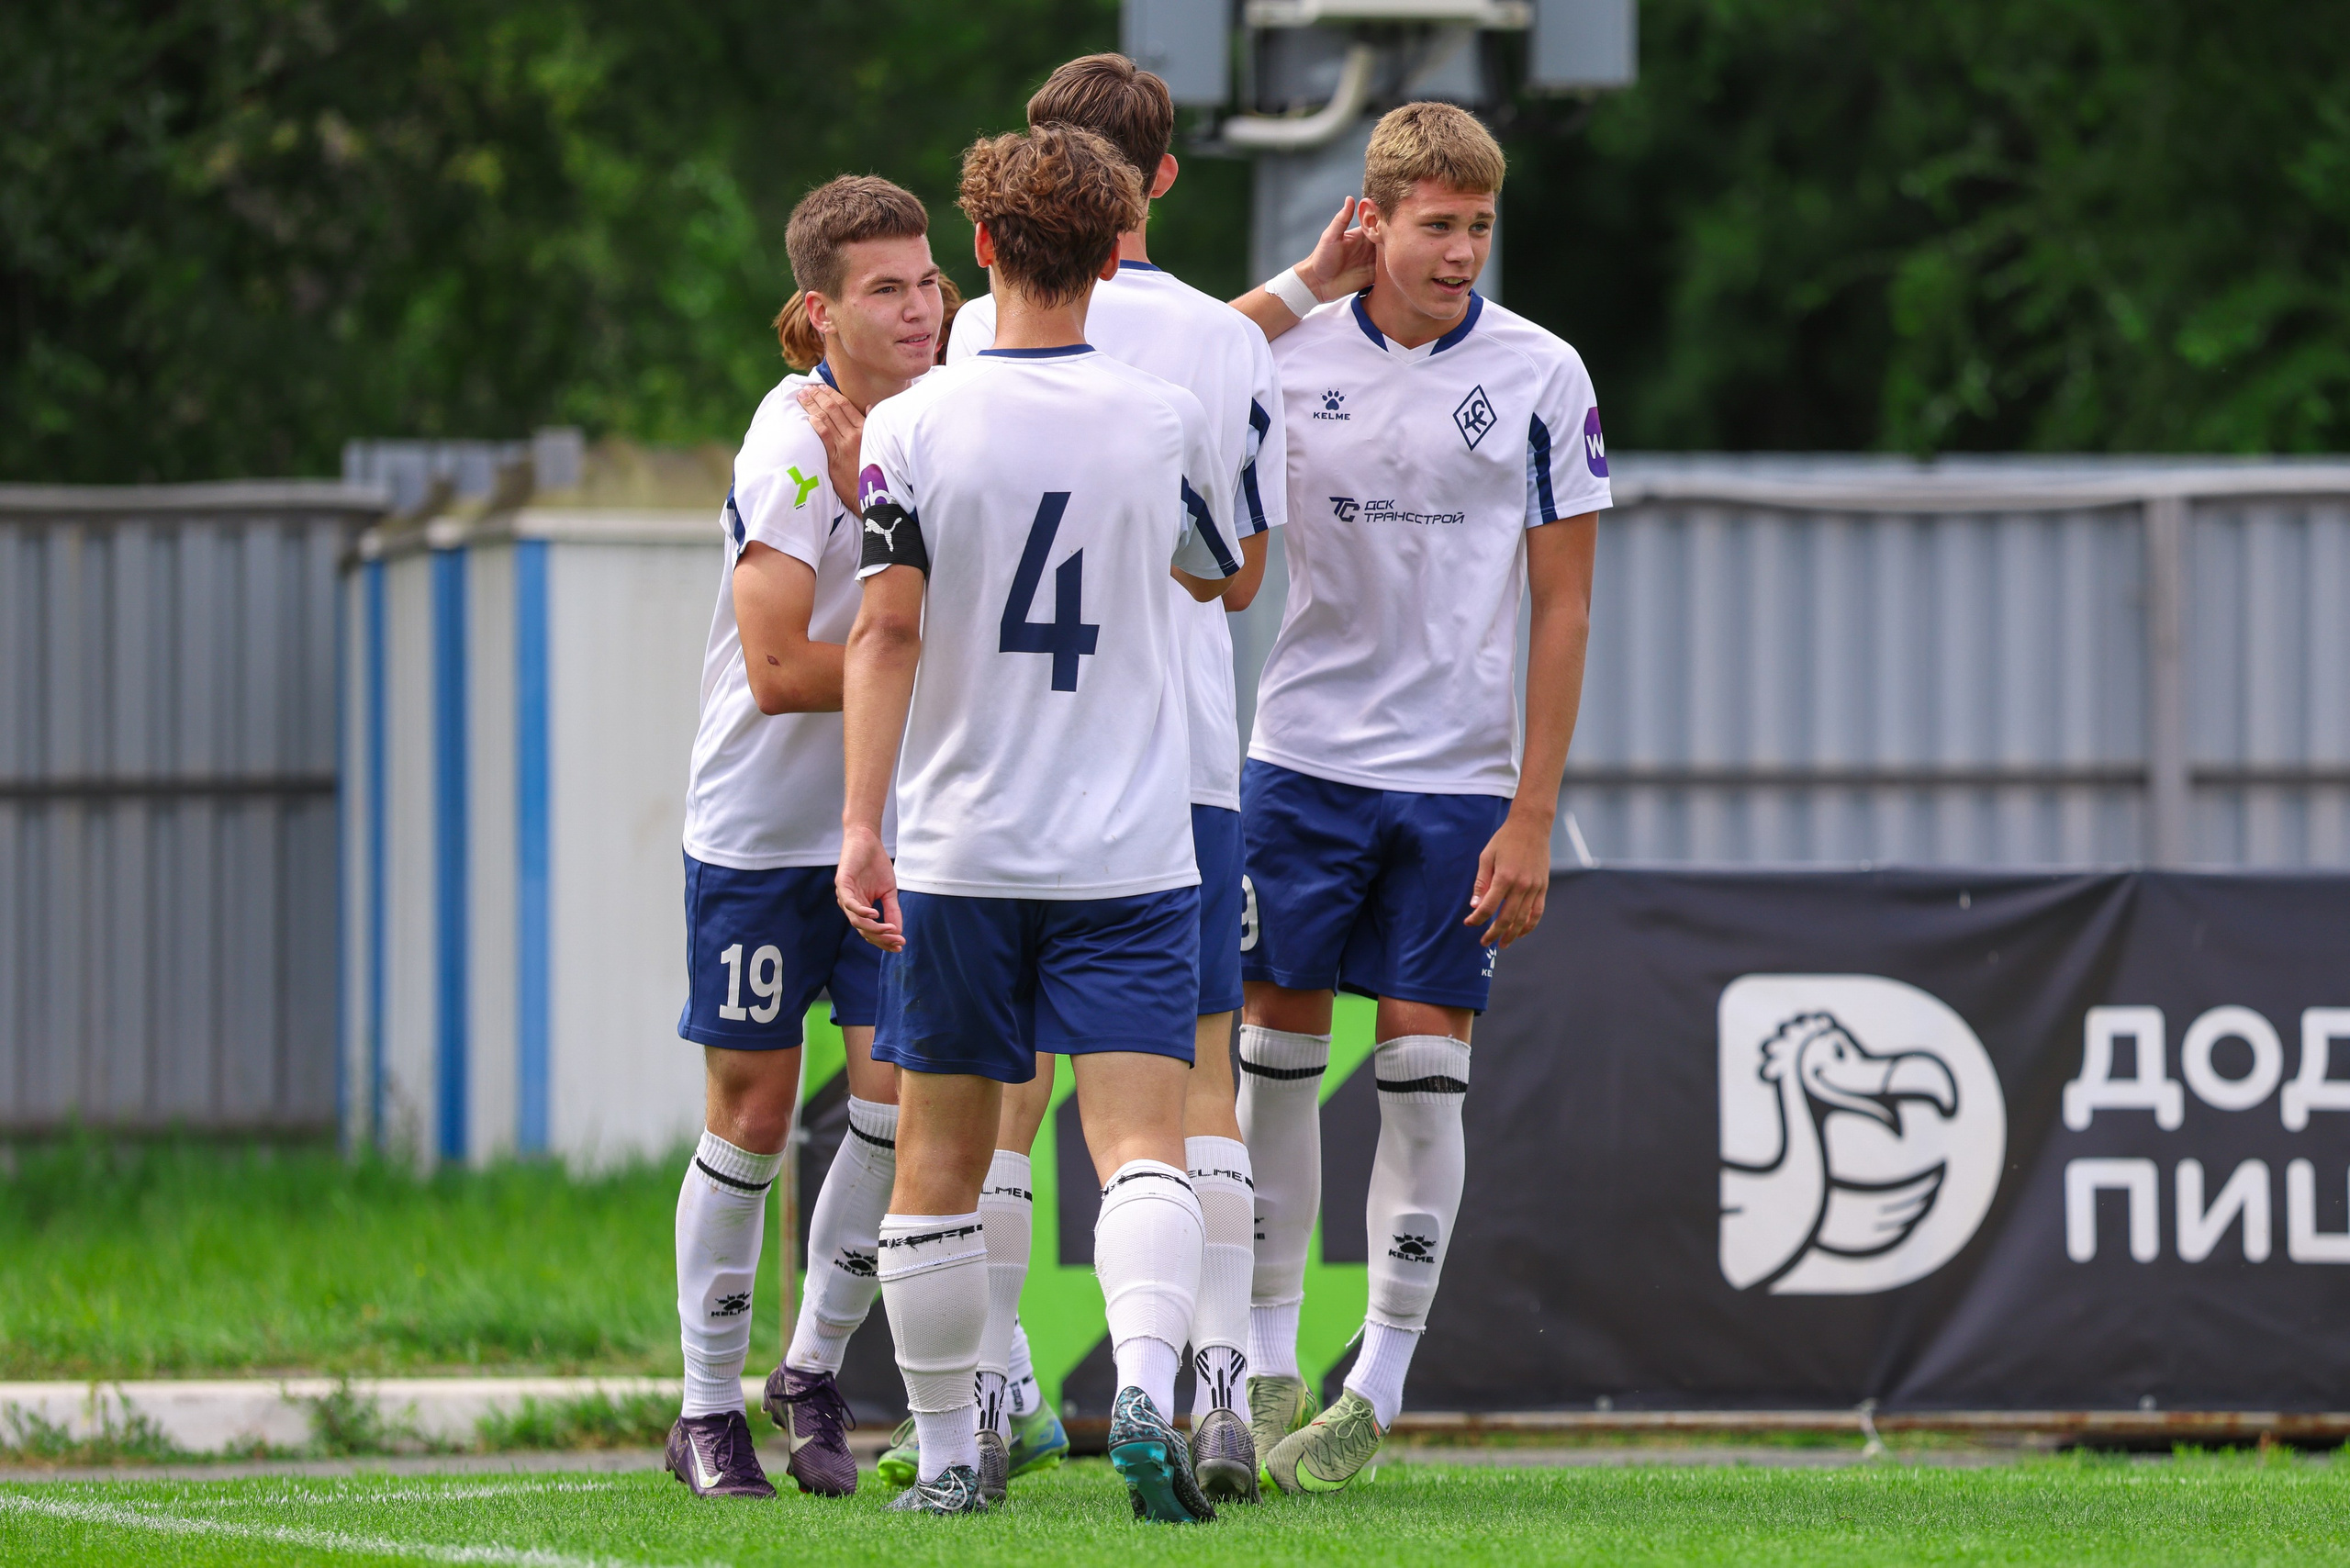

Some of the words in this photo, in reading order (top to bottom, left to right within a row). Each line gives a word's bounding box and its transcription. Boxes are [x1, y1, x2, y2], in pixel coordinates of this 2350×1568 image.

[1313, 411, 1351, 420] KELME
[1364, 499, 1395, 511] ДСК
[1364, 511, 1465, 525] ТРАНССТРОЙ
[999, 491, 1100, 692] 4
[719, 943, 783, 1025] 19
[1188, 1169, 1243, 1182] ELME
[981, 1186, 1022, 1198] LME
[1388, 1249, 1435, 1264] KELME
